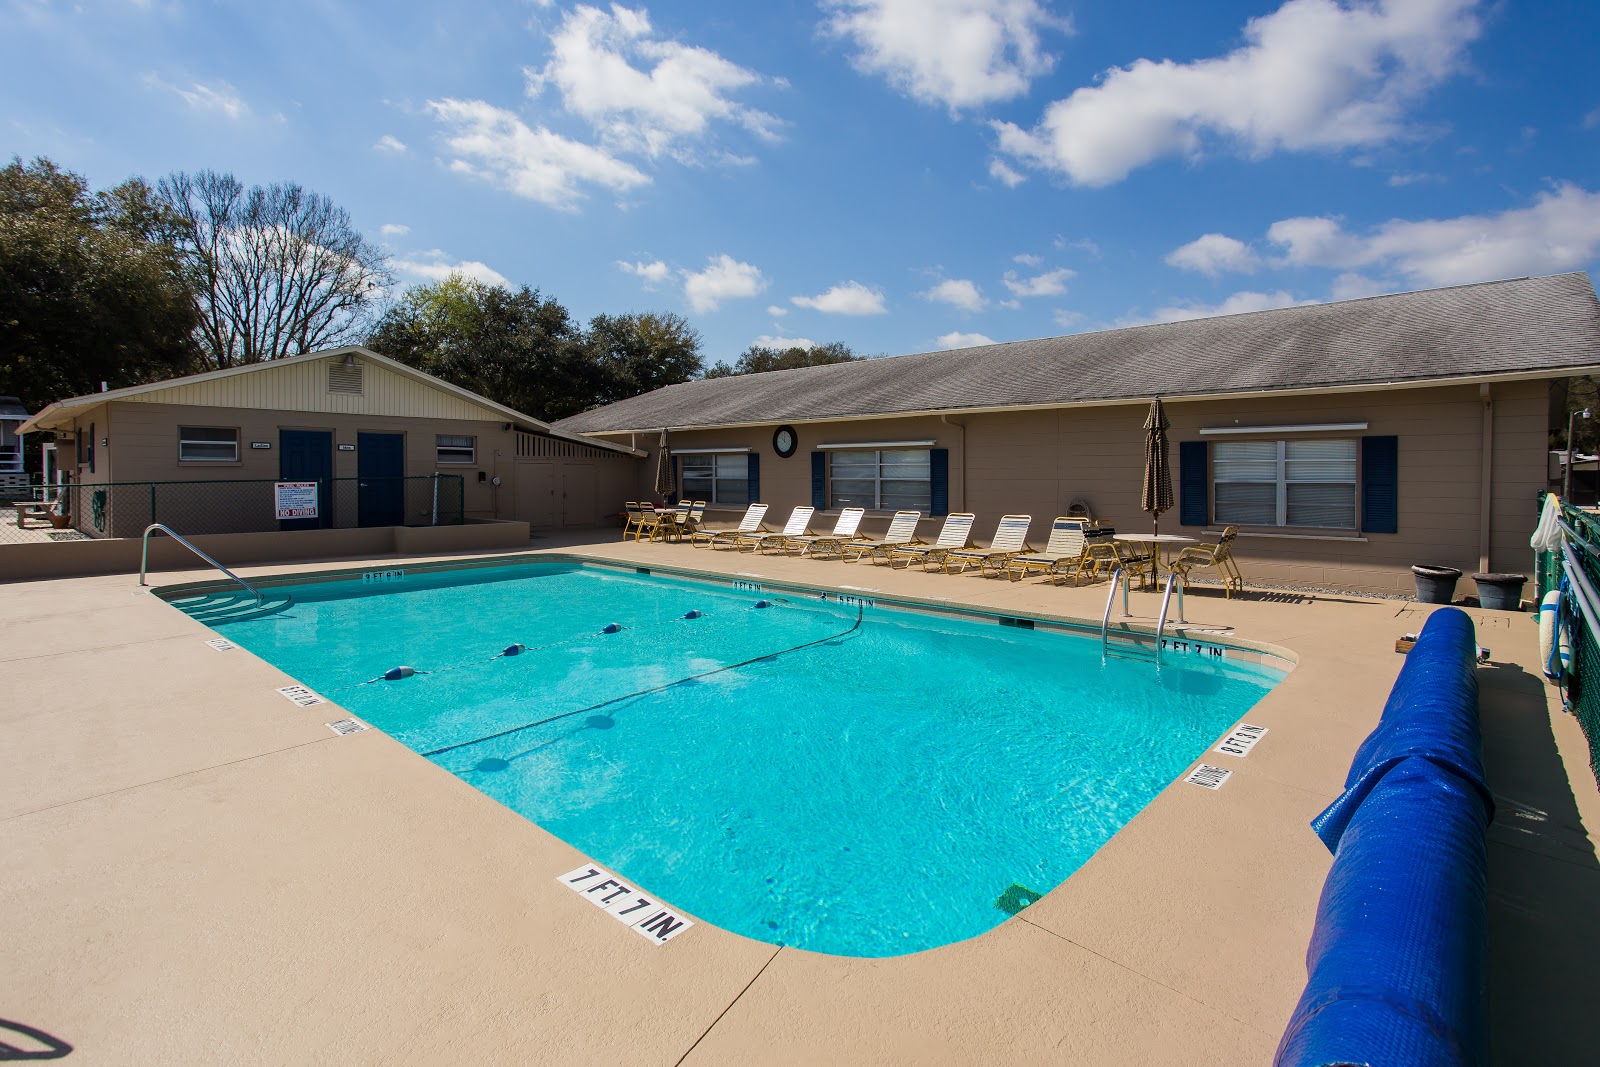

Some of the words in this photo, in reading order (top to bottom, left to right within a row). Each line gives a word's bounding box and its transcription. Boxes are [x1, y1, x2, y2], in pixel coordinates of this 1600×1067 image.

[280, 509, 290, 517] NO
[292, 508, 314, 516] DIVING
[1162, 640, 1167, 648] 7
[1173, 641, 1188, 651] FT
[1195, 645, 1202, 653] 7
[1209, 646, 1222, 656] IN
[286, 689, 308, 697] FT
[1240, 724, 1265, 734] IN
[1225, 737, 1251, 749] FT
[1220, 746, 1243, 754] 8
[569, 868, 601, 883] 7
[587, 879, 632, 904] FT.
[618, 898, 651, 915] 7
[640, 911, 684, 941] IN.
